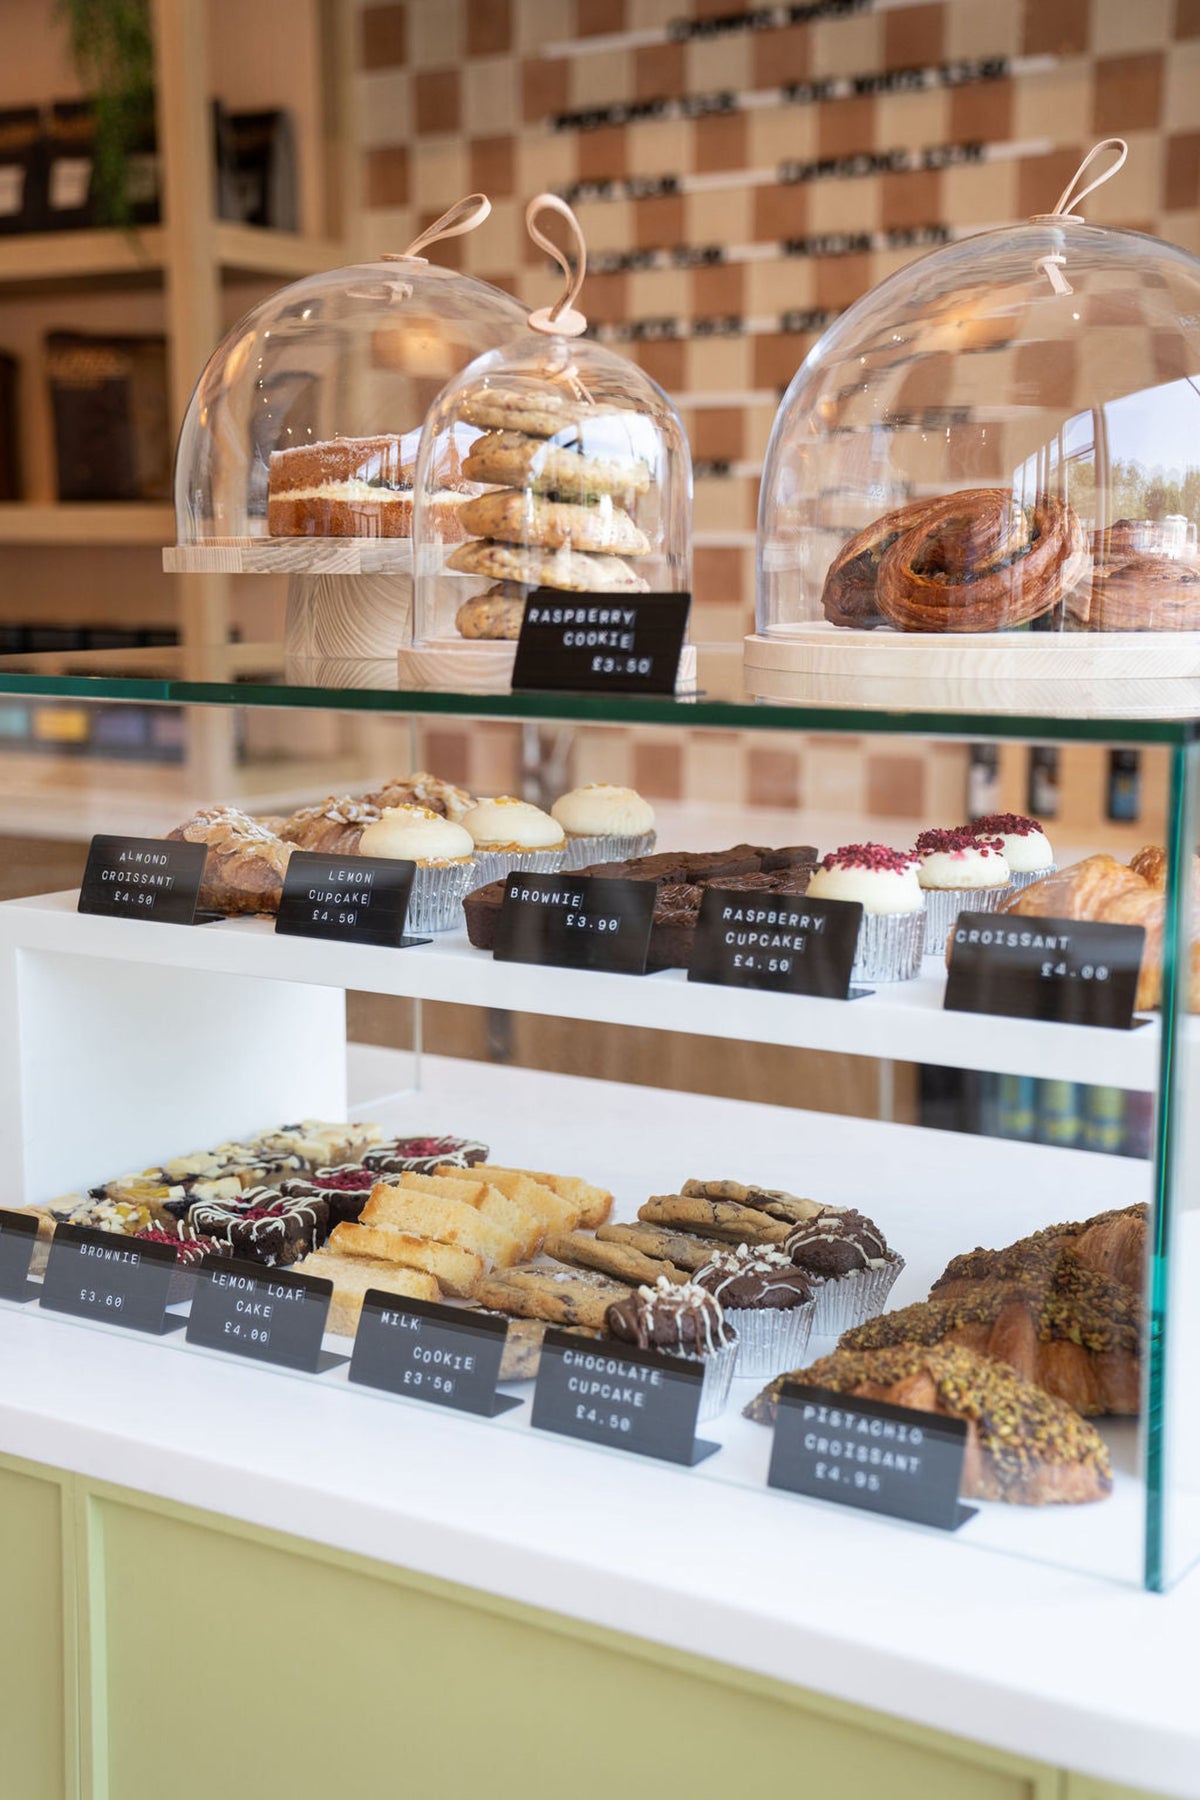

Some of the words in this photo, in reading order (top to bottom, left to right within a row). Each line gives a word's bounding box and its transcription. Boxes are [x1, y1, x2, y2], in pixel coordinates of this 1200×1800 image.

[528, 608, 634, 626] RASPBERRY
[563, 631, 631, 650] COOKIE
[591, 656, 650, 674] £3.50
[119, 850, 167, 865] ALMOND
[102, 870, 172, 886] CROISSANT
[328, 870, 372, 884] LEMON
[114, 890, 153, 905] £4.50
[308, 889, 369, 905] CUPCAKE
[510, 887, 581, 907] BROWNIE
[312, 909, 355, 924] £4.50
[566, 914, 618, 931] £3.90
[722, 907, 824, 931] RASPBERRY
[725, 931, 803, 950] CUPCAKE
[955, 929, 1071, 950] CROISSANT
[733, 954, 790, 972] £4.50
[1041, 962, 1109, 981] £4.00
[80, 1243, 140, 1265] BROWNIE
[212, 1271, 255, 1292] LEMON
[267, 1284, 304, 1301] LOAF
[80, 1289, 123, 1308] £3.60
[236, 1300, 272, 1318] CAKE
[380, 1311, 420, 1331] MILK
[224, 1321, 269, 1343] £4.00
[413, 1346, 474, 1371] COOKIE
[562, 1350, 661, 1386] CHOCOLATE
[567, 1377, 645, 1408] CUPCAKE
[575, 1404, 632, 1432] £4.50
[803, 1405, 924, 1446] PISTACHIO
[804, 1432, 922, 1474] CROISSANT
